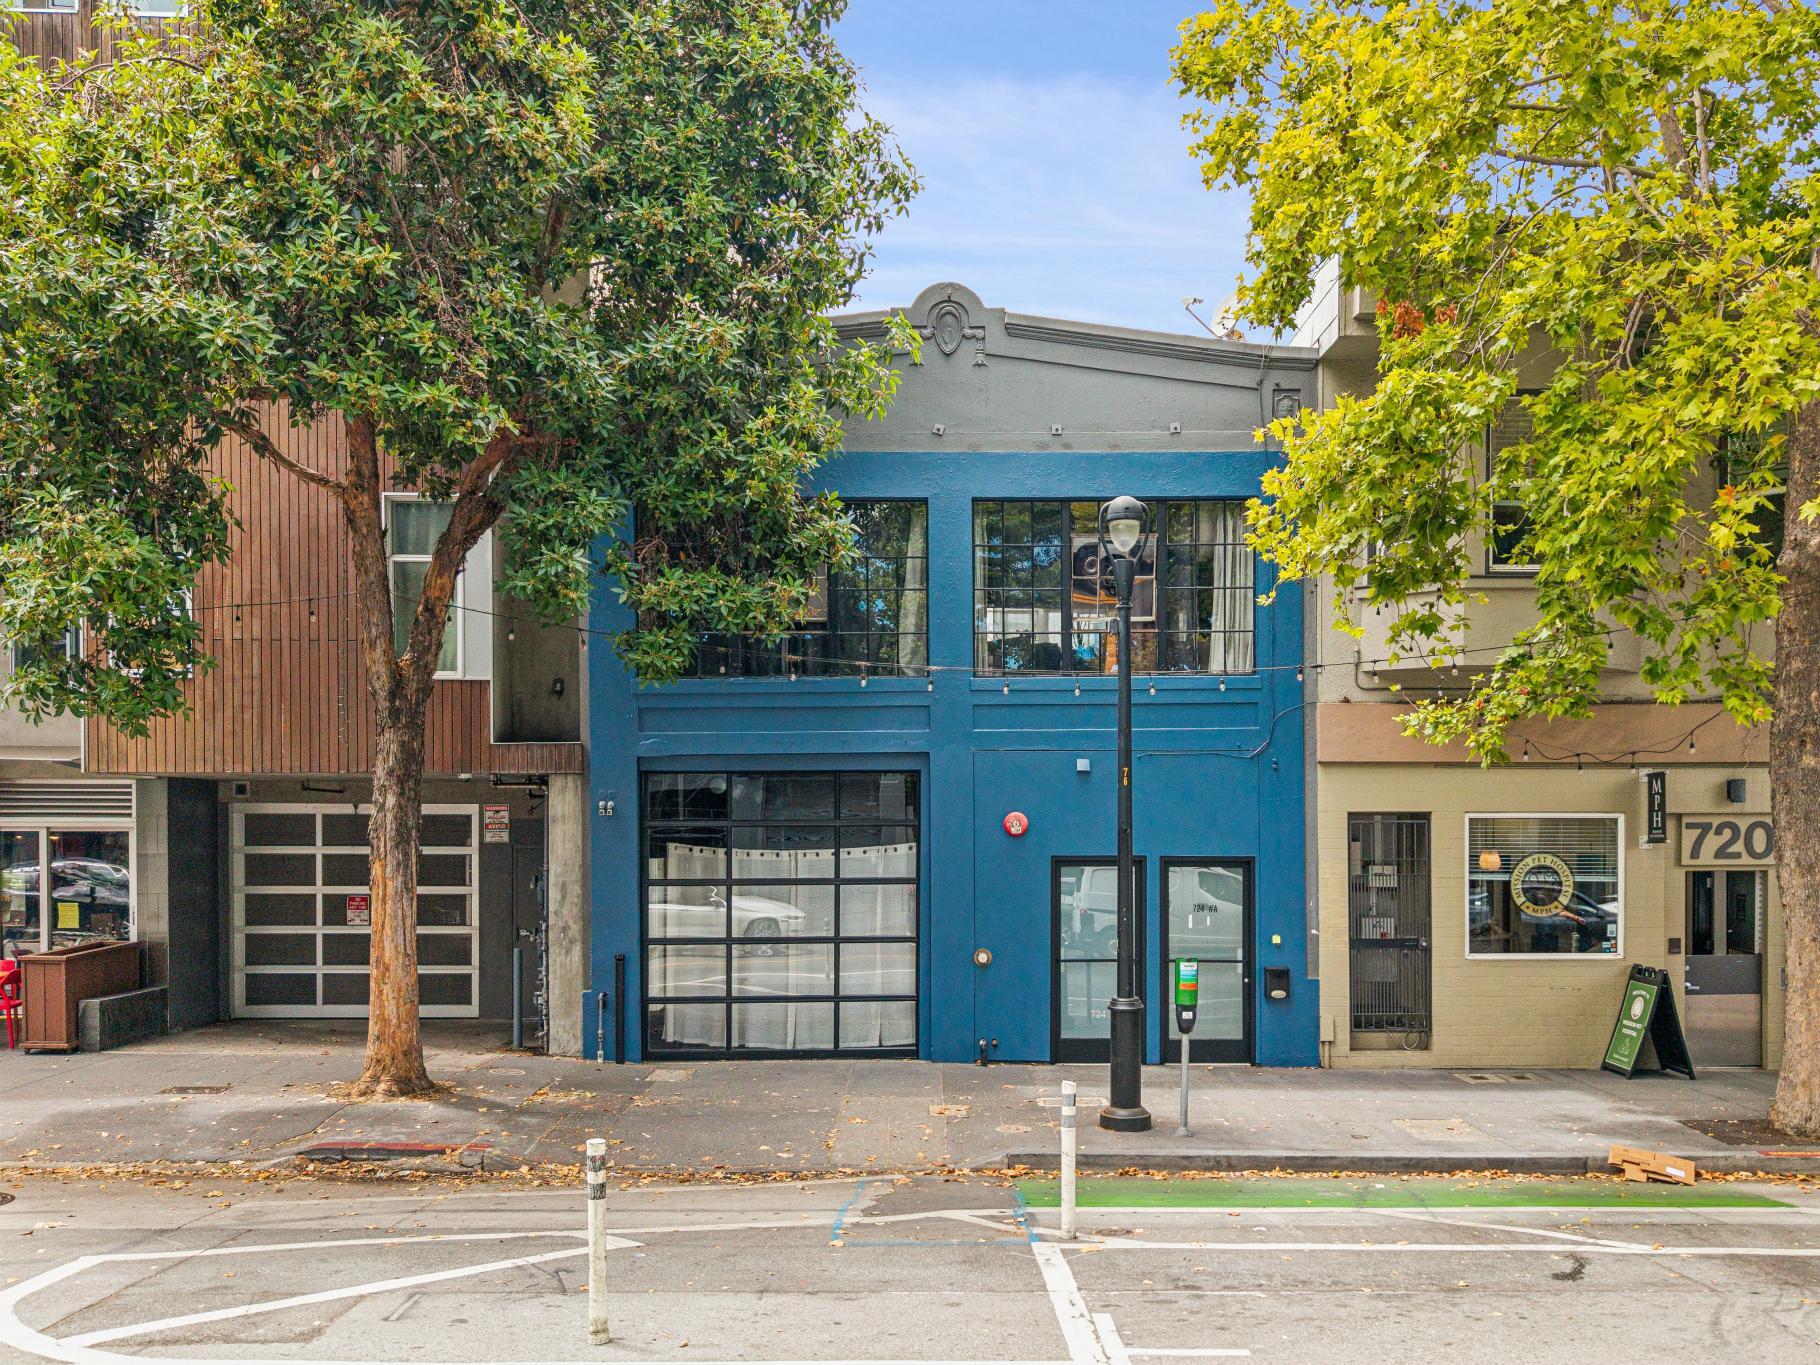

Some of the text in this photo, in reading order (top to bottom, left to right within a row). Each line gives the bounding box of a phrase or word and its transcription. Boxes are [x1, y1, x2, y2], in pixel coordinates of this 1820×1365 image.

[1685, 820, 1775, 860] 720
[1513, 856, 1571, 899] MISSION PET HOSPITAL
[1193, 904, 1204, 913] 724
[1531, 907, 1552, 915] MPH
